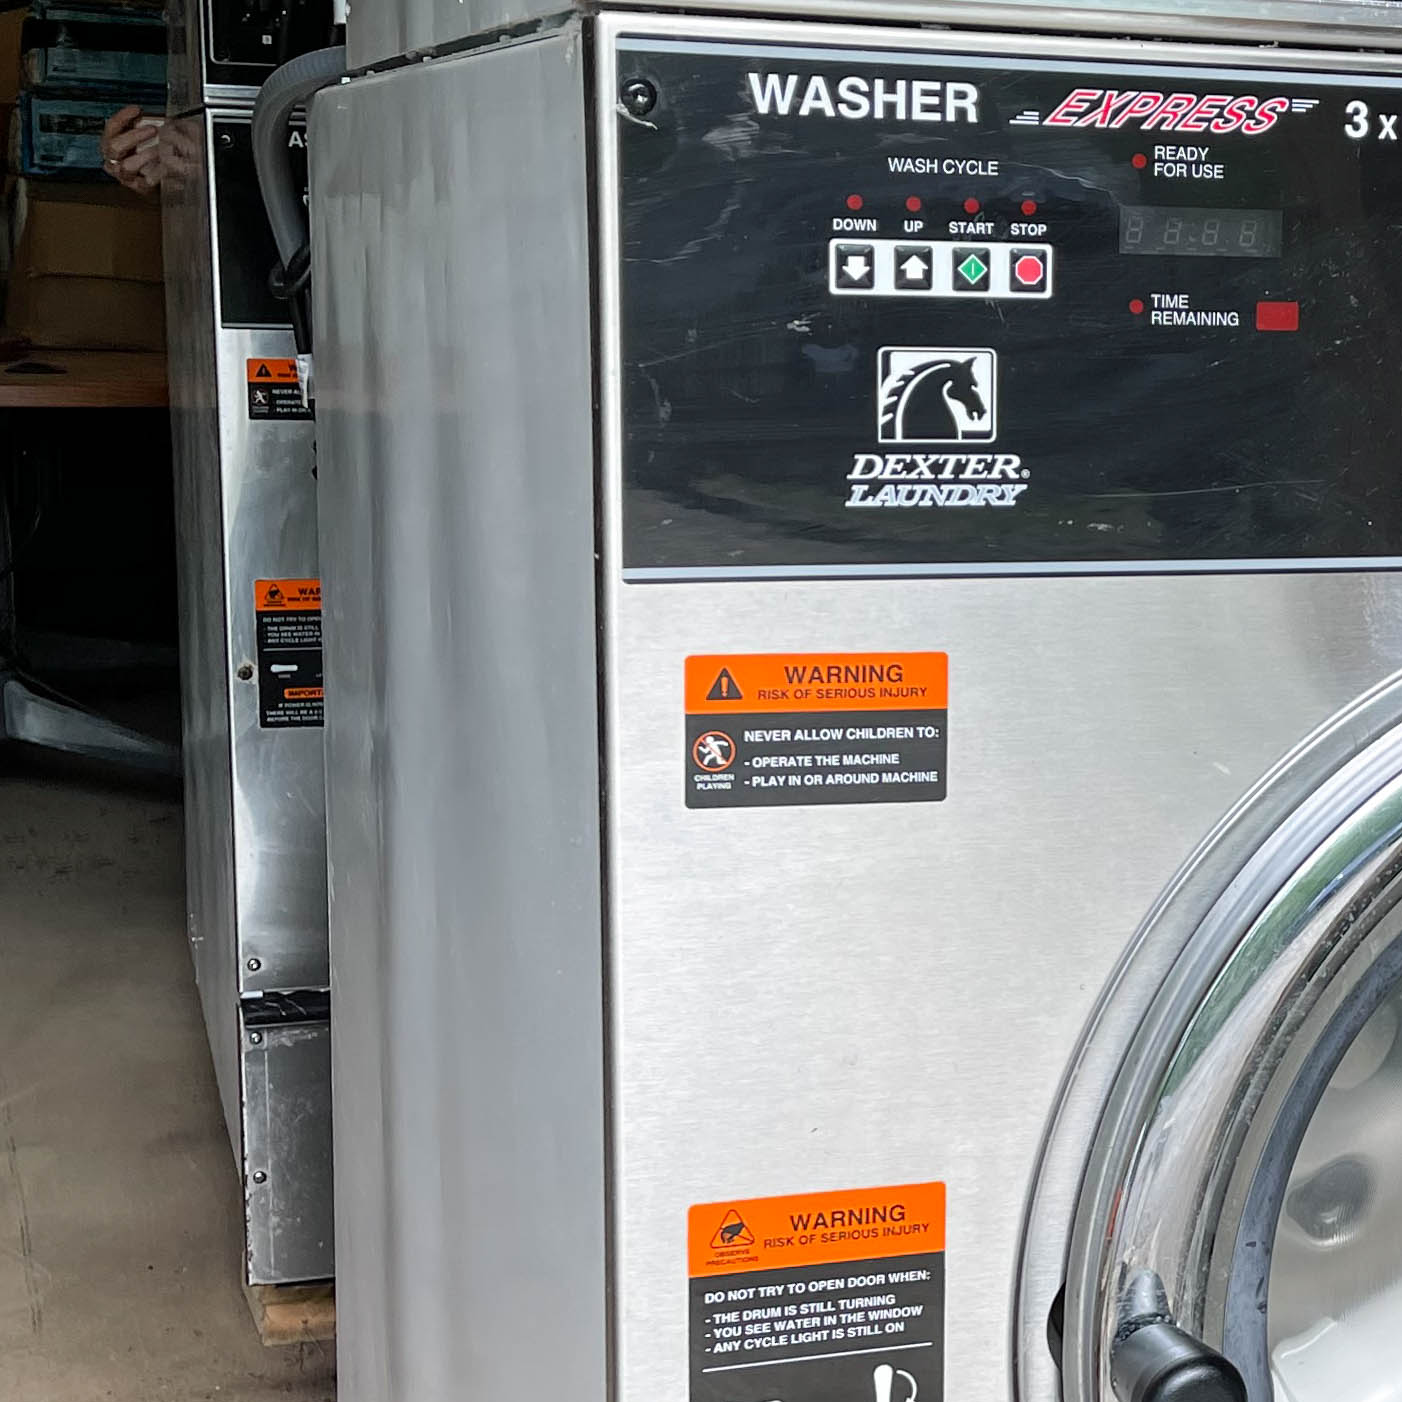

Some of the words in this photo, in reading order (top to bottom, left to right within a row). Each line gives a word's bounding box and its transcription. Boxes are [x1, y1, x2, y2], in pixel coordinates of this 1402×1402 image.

[748, 72, 978, 123] WASHER
[1042, 88, 1289, 135] EXPRESS
[1344, 100, 1369, 138] 3
[1155, 147, 1208, 161] READY
[888, 157, 938, 173] WASH
[943, 160, 999, 175] CYCLE
[1155, 164, 1188, 177] FOR
[1192, 164, 1224, 178] USE
[833, 219, 877, 231] DOWN
[904, 220, 923, 232] UP
[949, 222, 994, 234] START
[1010, 223, 1047, 236] STOP
[1151, 295, 1188, 309] TIME
[1151, 311, 1239, 326] REMAINING
[845, 484, 1028, 506] LAUNDRY
[784, 664, 903, 684] WARNING
[758, 690, 788, 700] RISK
[794, 689, 812, 699] OF
[816, 688, 875, 698] SERIOUS
[880, 687, 927, 697] INJURY
[744, 730, 791, 742] NEVER
[794, 729, 842, 741] ALLOW
[846, 727, 913, 739] CHILDREN
[916, 727, 939, 738] TO:
[752, 756, 812, 767] OPERATE
[815, 755, 839, 766] THE
[843, 754, 900, 765] MACHINE
[694, 774, 735, 782] CHILDREN
[697, 782, 731, 790] PLAYING
[752, 775, 786, 787] PLAY
[788, 775, 801, 786] IN
[805, 774, 822, 785] OR
[826, 773, 879, 785] AROUND
[882, 771, 938, 783] MACHINE
[790, 1205, 905, 1231] WARNING
[764, 1237, 793, 1249] RISK
[800, 1235, 815, 1245] OF
[821, 1229, 878, 1243] SERIOUS
[883, 1224, 929, 1237] INJURY
[705, 1291, 725, 1304] DO
[728, 1289, 755, 1302] NOT
[757, 1286, 785, 1298] TRY
[787, 1283, 805, 1295] TO
[809, 1280, 844, 1293] OPEN
[847, 1276, 885, 1288] DOOR
[888, 1271, 931, 1284] WHEN:
[713, 1311, 740, 1324] THE
[743, 1308, 781, 1321] DRUM
[784, 1306, 797, 1318] IS
[800, 1302, 835, 1315] STILL
[838, 1295, 895, 1311] TURNING
[714, 1326, 741, 1339] YOU
[745, 1323, 771, 1335] SEE
[774, 1319, 820, 1332] WATER
[824, 1317, 836, 1328] IN
[840, 1313, 865, 1325] THE
[868, 1305, 923, 1321] WINDOW
[714, 1340, 741, 1354] ANY
[744, 1335, 788, 1350] CYCLE
[791, 1329, 831, 1344] LIGHT
[832, 1327, 845, 1339] IS
[847, 1325, 882, 1338] STILL
[885, 1322, 904, 1333] ON
